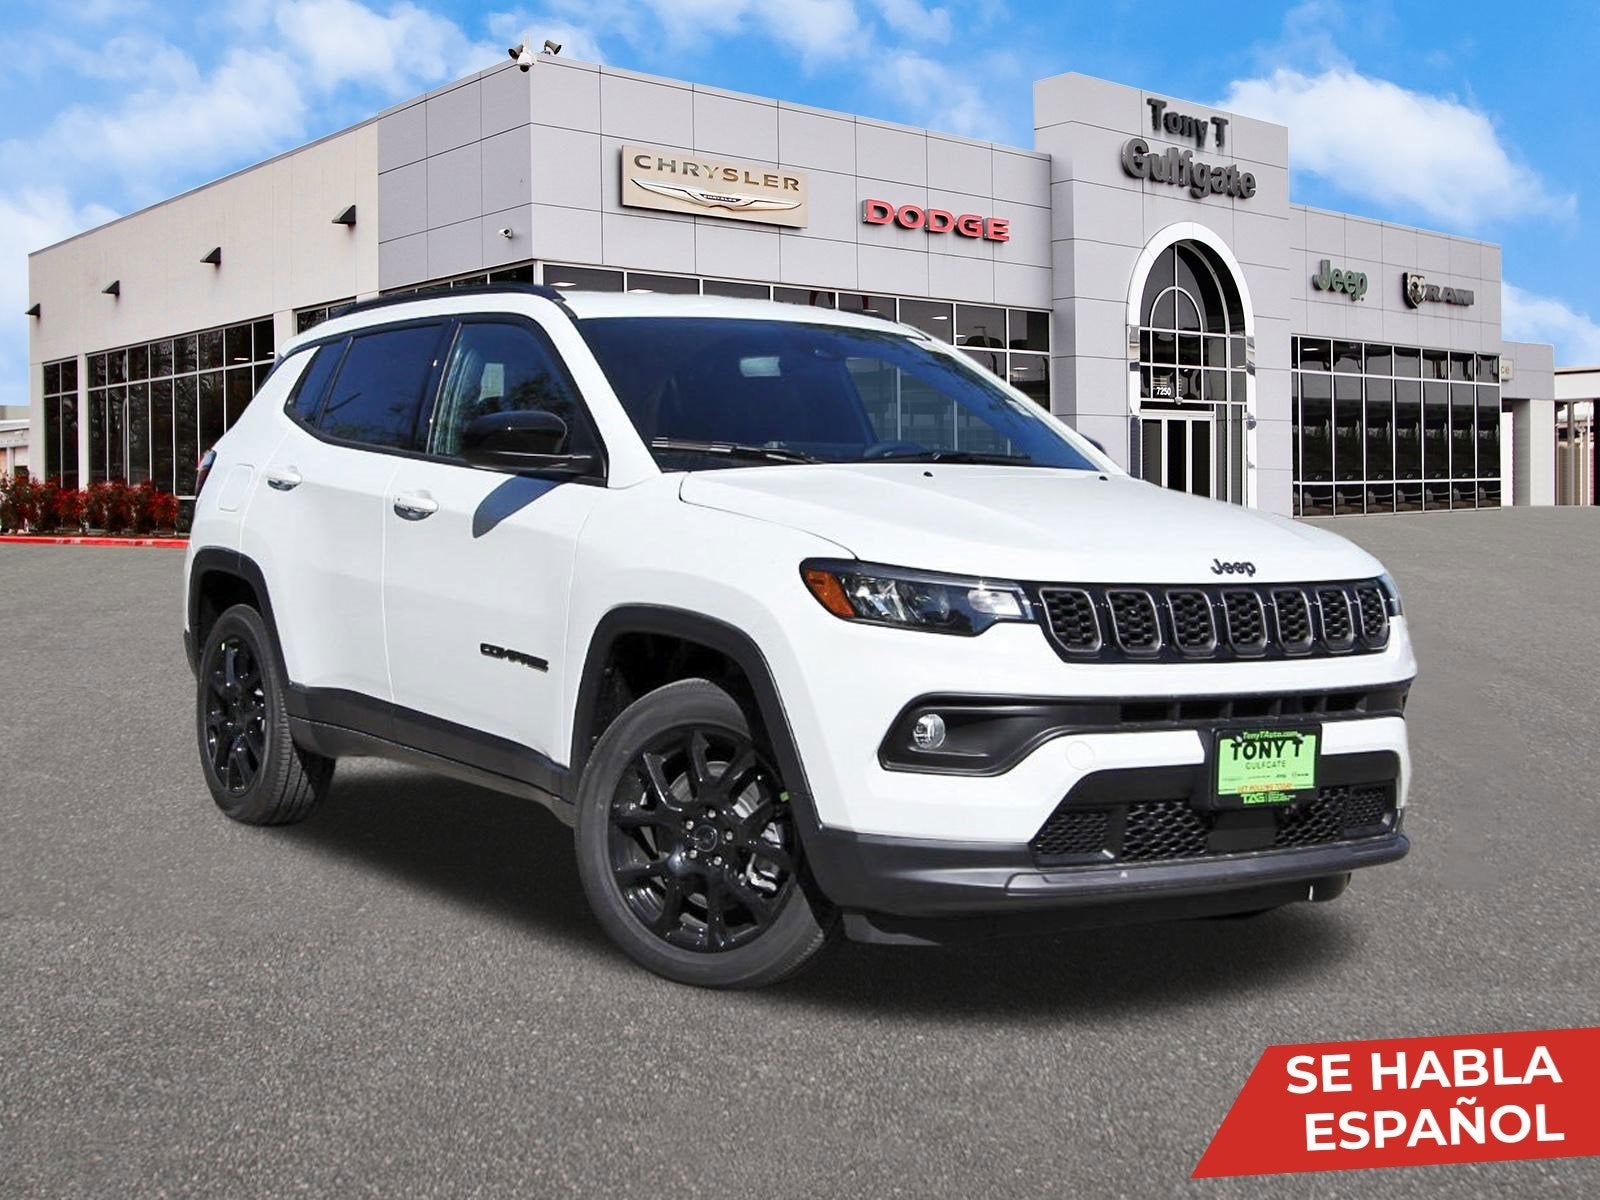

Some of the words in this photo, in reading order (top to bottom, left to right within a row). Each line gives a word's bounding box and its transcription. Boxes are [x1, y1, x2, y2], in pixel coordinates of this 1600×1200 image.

[1146, 98, 1208, 149] Tony
[1210, 116, 1229, 147] T
[633, 154, 800, 192] CHRYSLER
[1121, 138, 1257, 199] Gulfgate
[862, 198, 1010, 242] DODGE
[1312, 259, 1368, 302] Jeep
[1425, 284, 1474, 306] RAM
[1156, 386, 1172, 396] 7250
[1210, 558, 1256, 577] Jeep
[1230, 739, 1287, 760] TONY
[1292, 738, 1304, 757] T
